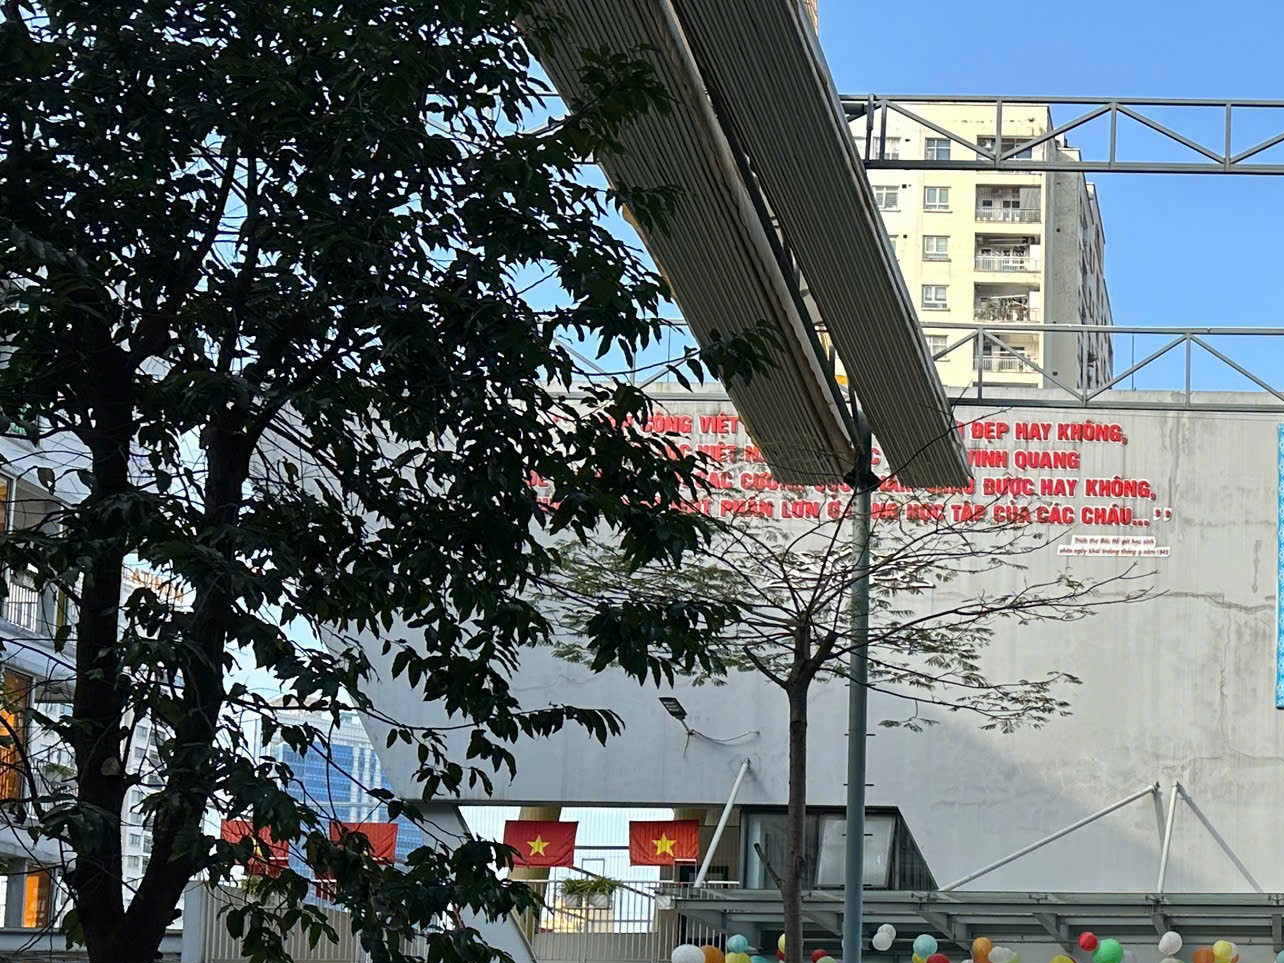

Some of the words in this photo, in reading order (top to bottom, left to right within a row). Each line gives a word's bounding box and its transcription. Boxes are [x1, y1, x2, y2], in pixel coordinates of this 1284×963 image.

[700, 412, 739, 439] VIỆT
[971, 421, 1009, 444] ĐẸP
[1015, 422, 1051, 441] HAY
[1057, 419, 1128, 445] KHÔNG,
[1014, 451, 1080, 470] QUANG
[983, 476, 1034, 500] ĐƯỢC
[1041, 478, 1077, 497] HAY
[1085, 475, 1157, 501] KHÔNG,
[951, 500, 986, 526] TẬP
